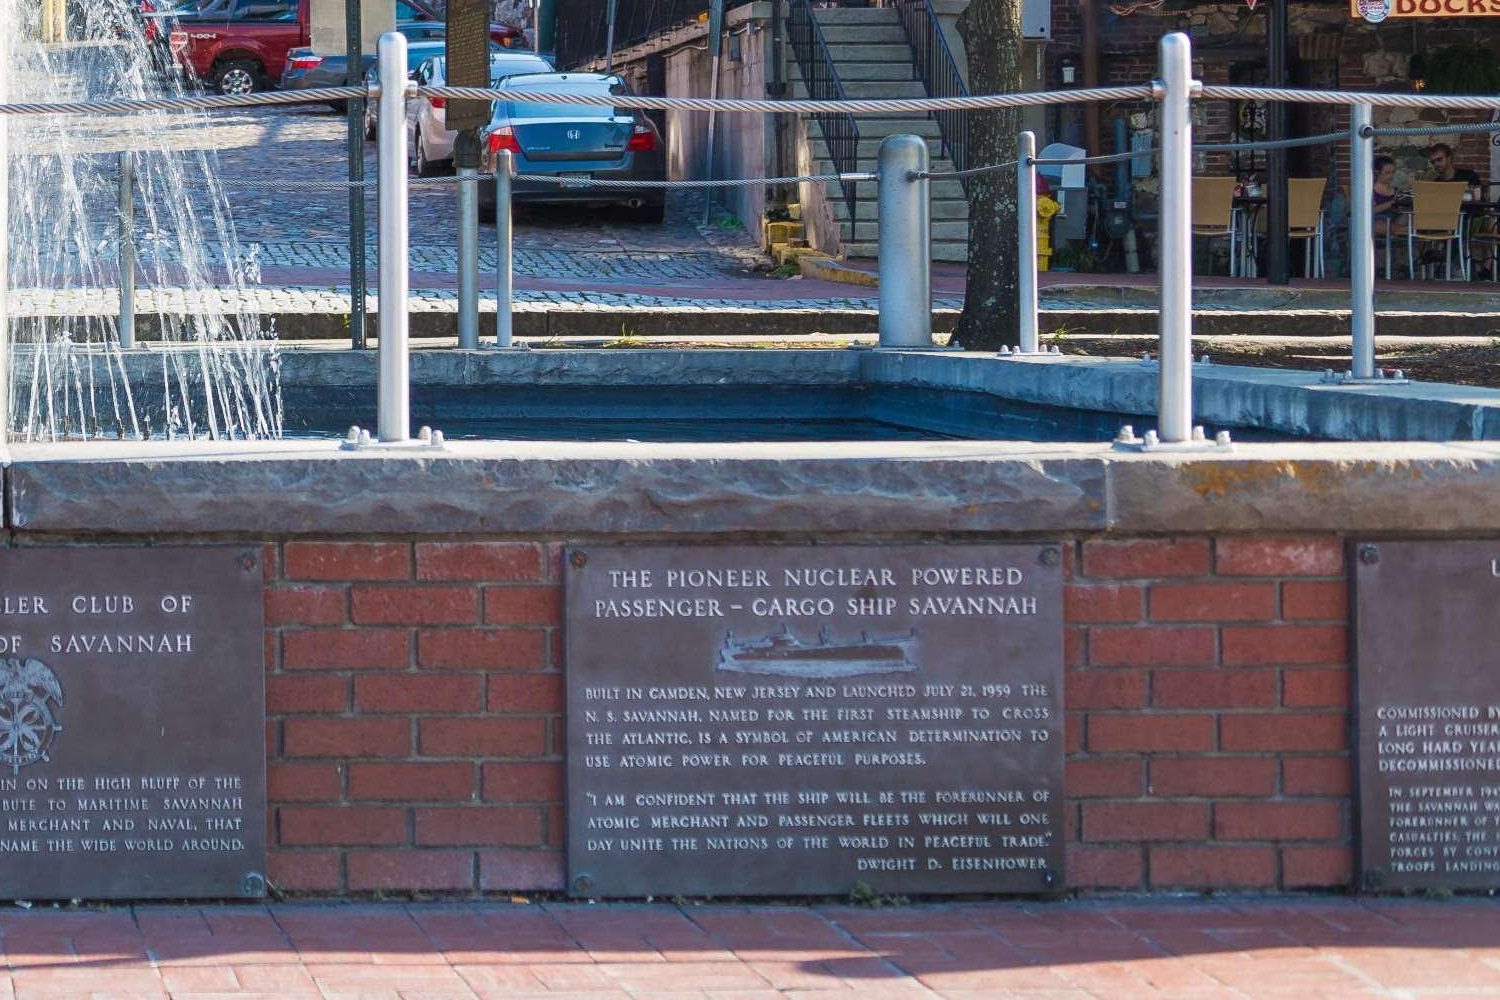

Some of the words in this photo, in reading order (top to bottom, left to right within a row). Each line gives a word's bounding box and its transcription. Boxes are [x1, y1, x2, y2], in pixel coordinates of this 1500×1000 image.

[608, 570, 652, 588] THE
[667, 569, 770, 588] PIONEER
[784, 568, 896, 587] NUCLEAR
[911, 568, 1022, 587] POWERED
[72, 596, 133, 615] CLUB
[161, 596, 192, 615] OF
[595, 599, 724, 618] PASSENGER
[752, 598, 834, 617] CARGO
[846, 598, 896, 617] SHIP
[909, 597, 1036, 616] SAVANNAH
[50, 635, 191, 654] SAVANNAH
[585, 688, 620, 700] BUILT
[626, 688, 642, 700] IN
[649, 687, 710, 700] CAMDEN,
[714, 687, 746, 699] NEW
[751, 687, 800, 699] JERSEY
[805, 686, 836, 699] AND
[843, 686, 915, 698] LAUNCHED
[923, 686, 954, 698] JULY
[982, 685, 1010, 697] 1959
[1021, 685, 1047, 697] THE
[1377, 707, 1479, 720] COMMISSIONED
[586, 733, 612, 745] THE
[698, 732, 711, 744] IS
[718, 732, 728, 744] A
[735, 732, 788, 744] SYMBOL
[796, 732, 812, 743] OF
[822, 731, 896, 743] AMERICAN
[908, 731, 1021, 743] DETERMINATION
[1030, 730, 1048, 742] TO
[1379, 725, 1387, 737] A
[1396, 724, 1435, 737] LIGHT
[1379, 742, 1415, 754] LONG
[1423, 742, 1462, 754] HARD
[585, 756, 610, 767] USE
[619, 755, 672, 767] ATOMIC
[682, 755, 731, 767] POWER
[741, 754, 768, 766] FOR
[778, 754, 844, 766] PEACEFUL
[854, 753, 926, 766] PURPOSES.
[26, 779, 48, 791] ON
[56, 779, 84, 791] THE
[95, 778, 130, 791] HIGH
[141, 778, 179, 791] BLUFF
[188, 778, 205, 790] OF
[214, 778, 240, 790] THE
[47, 799, 66, 812] TO
[78, 798, 148, 811] MARITIME
[163, 798, 242, 811] SAVANNAH
[8, 819, 90, 832] MERCHANT
[102, 819, 134, 831] AND
[148, 819, 197, 831] NAVAL,
[205, 818, 241, 831] THAT
[0, 840, 38, 853] NAME
[46, 840, 73, 853] THE
[80, 840, 116, 852] WIDE
[124, 840, 173, 852] WORLD
[857, 858, 915, 871] DWIGHT
[927, 858, 942, 871] D.
[952, 858, 1046, 871] EISENHOWER
